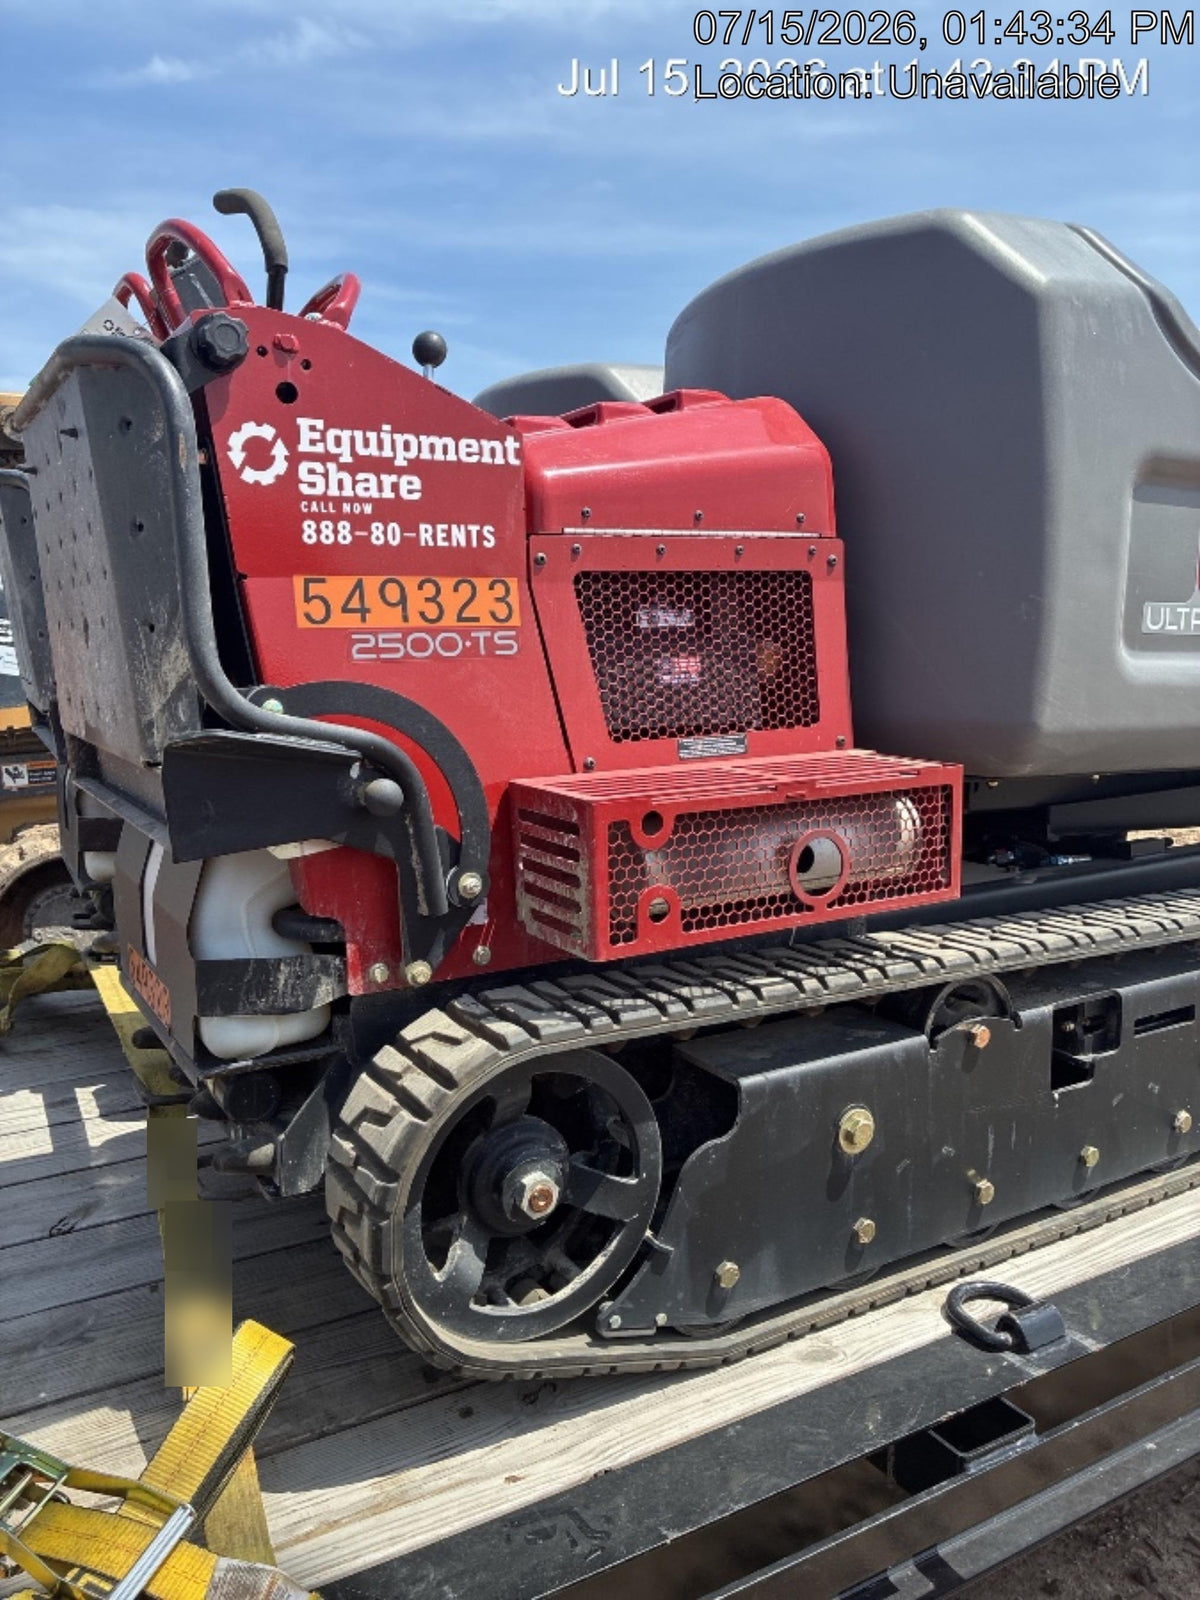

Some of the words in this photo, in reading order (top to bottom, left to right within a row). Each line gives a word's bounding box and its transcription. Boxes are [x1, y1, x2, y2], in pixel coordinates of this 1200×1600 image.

[296, 417, 521, 466] Equipment
[298, 461, 422, 500] Share
[301, 501, 336, 513] CALL
[342, 502, 373, 514] NOW
[302, 519, 496, 548] 888-80-RENTS
[302, 577, 513, 625] 549323
